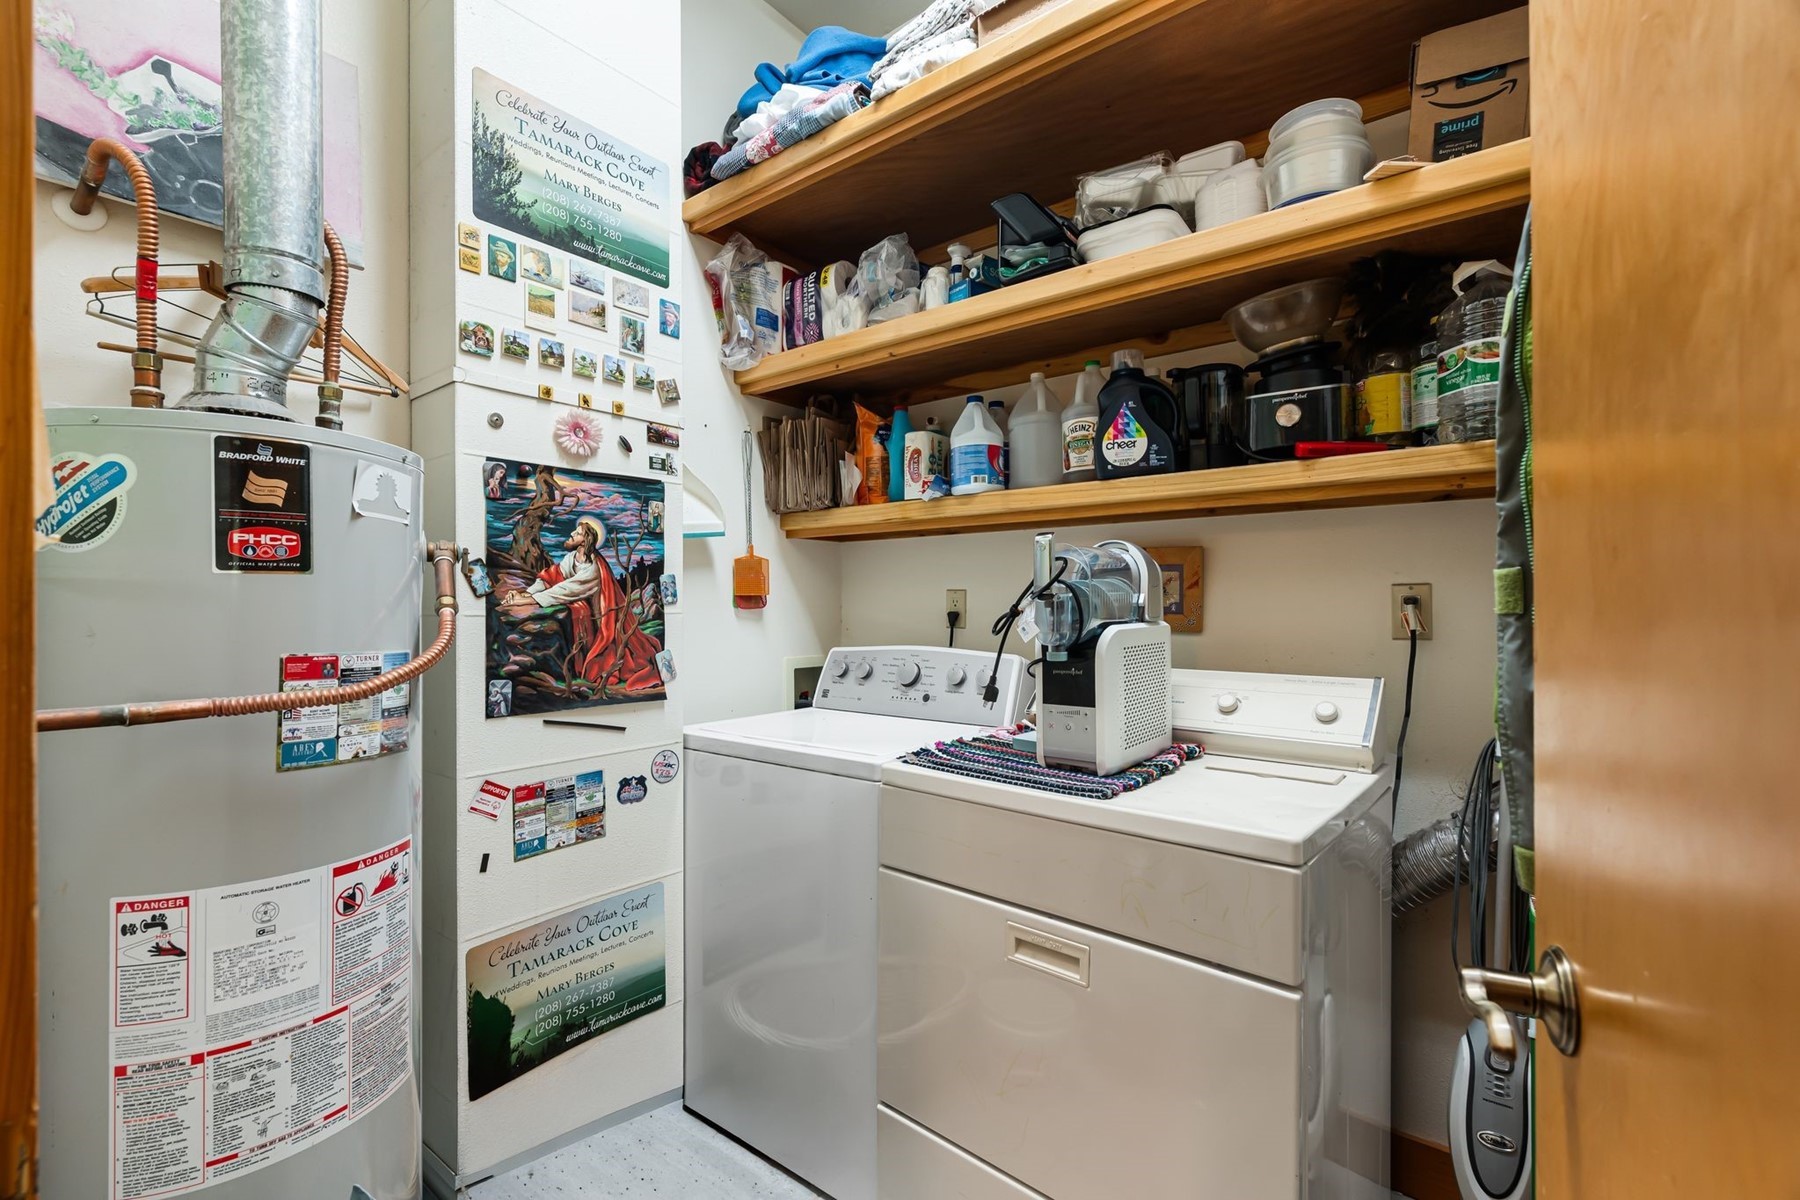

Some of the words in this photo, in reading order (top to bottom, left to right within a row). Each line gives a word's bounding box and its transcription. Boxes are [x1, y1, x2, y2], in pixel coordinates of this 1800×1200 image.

[495, 89, 553, 125] Celebrate
[551, 115, 580, 142] Your
[584, 132, 626, 163] Outdoor
[628, 155, 662, 179] Event
[1441, 115, 1480, 133] prime
[506, 133, 544, 158] Weddings,
[545, 151, 576, 172] Reunions
[577, 164, 607, 188] Meetings,
[608, 179, 634, 199] Lectures,
[635, 192, 660, 210] Concerts
[541, 201, 570, 223] (208)
[573, 214, 622, 242] 755-1280
[542, 187, 570, 209] (208)
[573, 202, 622, 227] 267-7387
[573, 239, 667, 281] www.tamarackcove.com
[807, 271, 817, 321] QUILTED
[1070, 424, 1091, 434] HEINZ
[1106, 440, 1137, 450] cheer
[218, 451, 273, 463] BRADFORD
[275, 456, 307, 466] WHITE
[36, 484, 90, 535] Hydrojet
[233, 532, 297, 546] PHCC
[482, 783, 508, 796] SUPPORTER
[655, 768, 671, 776] 175
[366, 847, 399, 866] DANGER
[134, 899, 184, 911] DANGER
[220, 891, 250, 900] AUTOMATIC
[250, 887, 274, 895] STORAGE
[488, 932, 544, 968] Celebrate
[543, 925, 572, 947] Your
[576, 909, 618, 931] Outdoor
[621, 894, 655, 917] Event
[499, 977, 537, 996] Weddings,
[538, 962, 568, 979] Reunions
[569, 952, 599, 968] Meetings,
[600, 940, 627, 954] Lectures,
[628, 930, 654, 943] Concerts
[534, 999, 562, 1022] (208)
[565, 976, 615, 1006] 267-7387
[534, 1015, 562, 1037] (208)
[565, 990, 616, 1020] 755-1280
[565, 994, 663, 1043] www.tamarackcove.com
